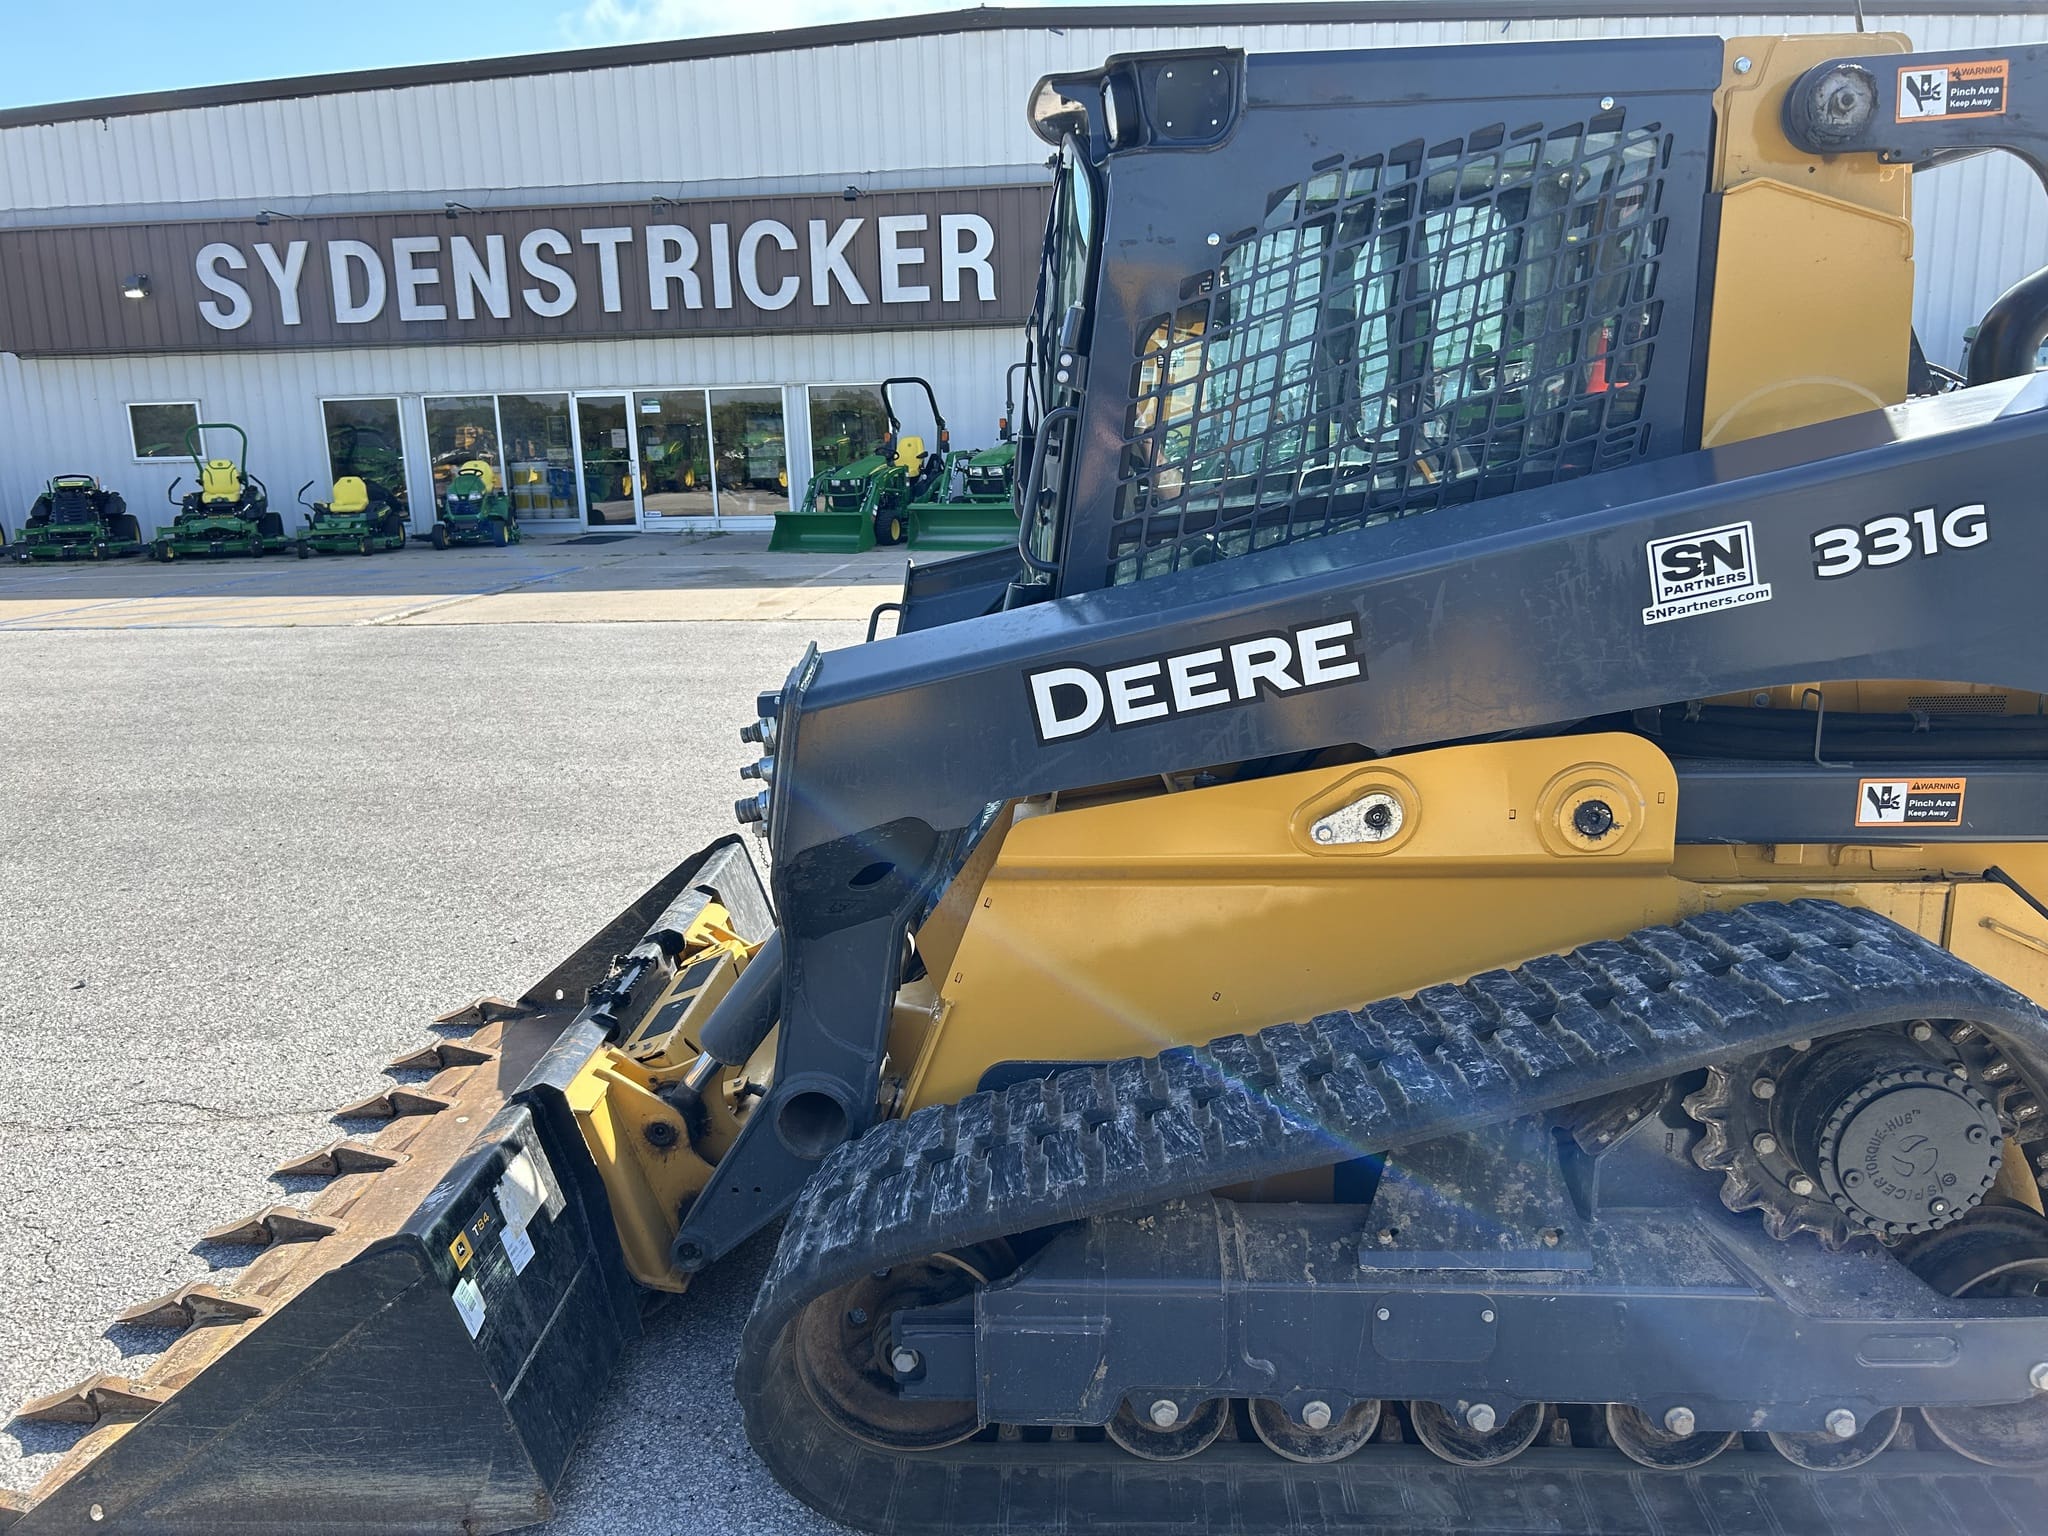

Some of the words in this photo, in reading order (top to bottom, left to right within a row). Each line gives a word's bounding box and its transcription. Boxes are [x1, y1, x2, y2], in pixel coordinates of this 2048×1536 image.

[1961, 65, 2003, 76] WARNING
[1949, 98, 1970, 108] Keep
[1971, 98, 1993, 107] Away
[1950, 86, 1976, 97] Pinch
[1977, 85, 2000, 95] Area
[195, 213, 998, 331] SYDENSTRICKER
[1813, 504, 1989, 577] 331G
[1664, 571, 1747, 597] PARTNERS
[1645, 588, 1770, 621] SNPartners.com
[1029, 620, 1362, 741] DEERE
[1920, 782, 1960, 791] WARNING
[1907, 809, 1926, 818] Keep
[1927, 809, 1949, 818] Away
[1908, 799, 1934, 808] Pinch
[1935, 799, 1957, 808] Area
[1873, 1176, 1938, 1201] SPICER
[471, 1211, 491, 1237] T84
